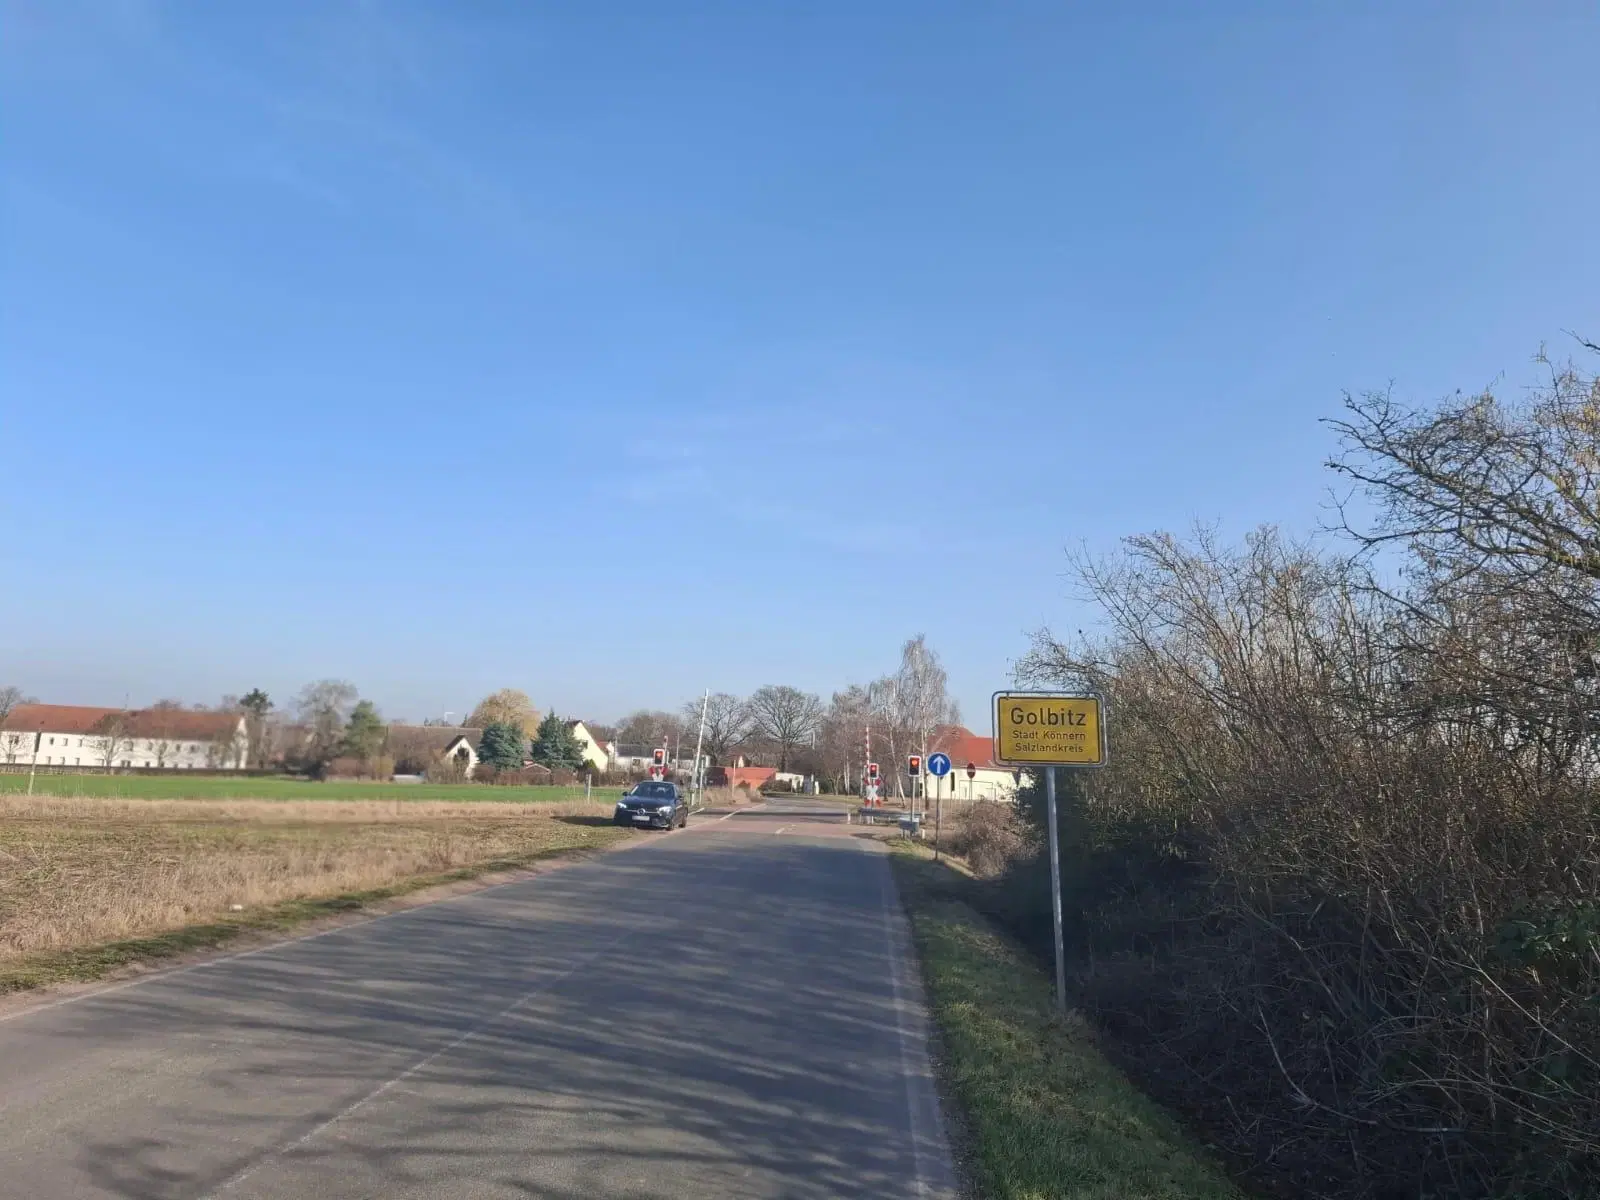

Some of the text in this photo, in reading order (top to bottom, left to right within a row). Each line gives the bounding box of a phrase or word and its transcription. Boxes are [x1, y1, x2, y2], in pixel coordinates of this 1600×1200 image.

[1010, 707, 1087, 726] Golbitz
[1012, 730, 1086, 741] Stadt Könnern
[1015, 742, 1084, 753] Salzlandkreis
